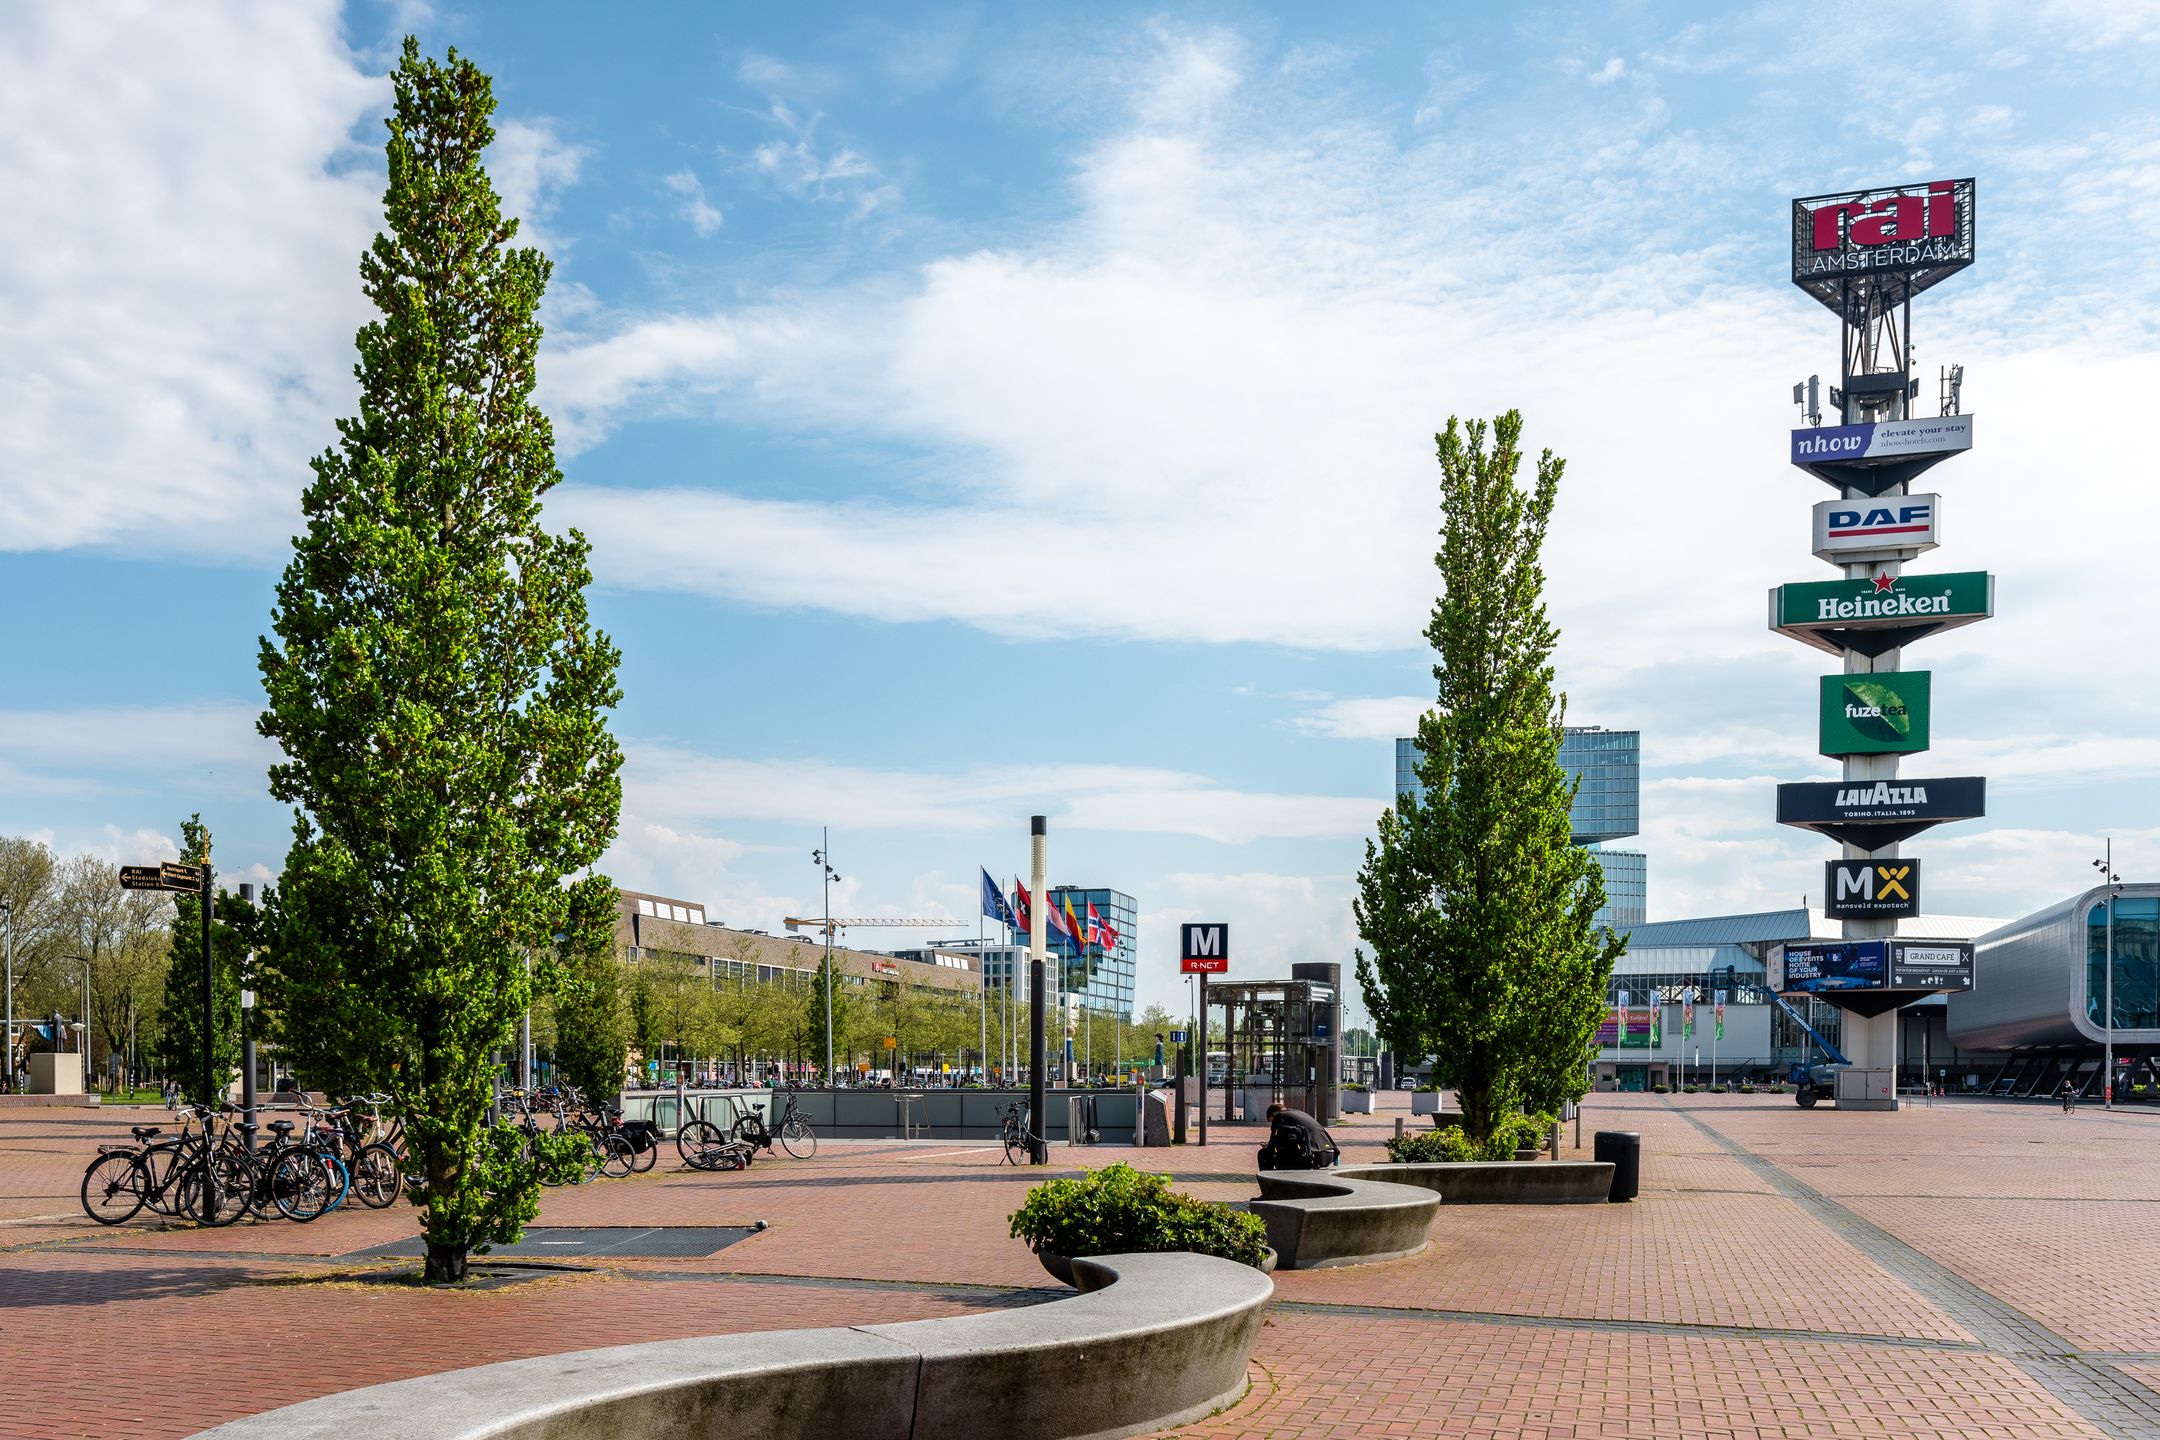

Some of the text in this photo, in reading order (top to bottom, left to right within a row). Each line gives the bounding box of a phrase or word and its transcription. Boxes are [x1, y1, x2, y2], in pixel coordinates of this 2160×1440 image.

[1813, 179, 1955, 250] rai
[1812, 242, 1955, 273] AMSTERDAM
[1881, 425, 1967, 438] elevate your stay
[1881, 437, 1945, 447] nhow-hotels.com
[1798, 435, 1862, 454] nhow
[1828, 505, 1930, 528] DAF
[1835, 782, 1928, 806] LAVAZZA
[1190, 927, 1220, 956] M
